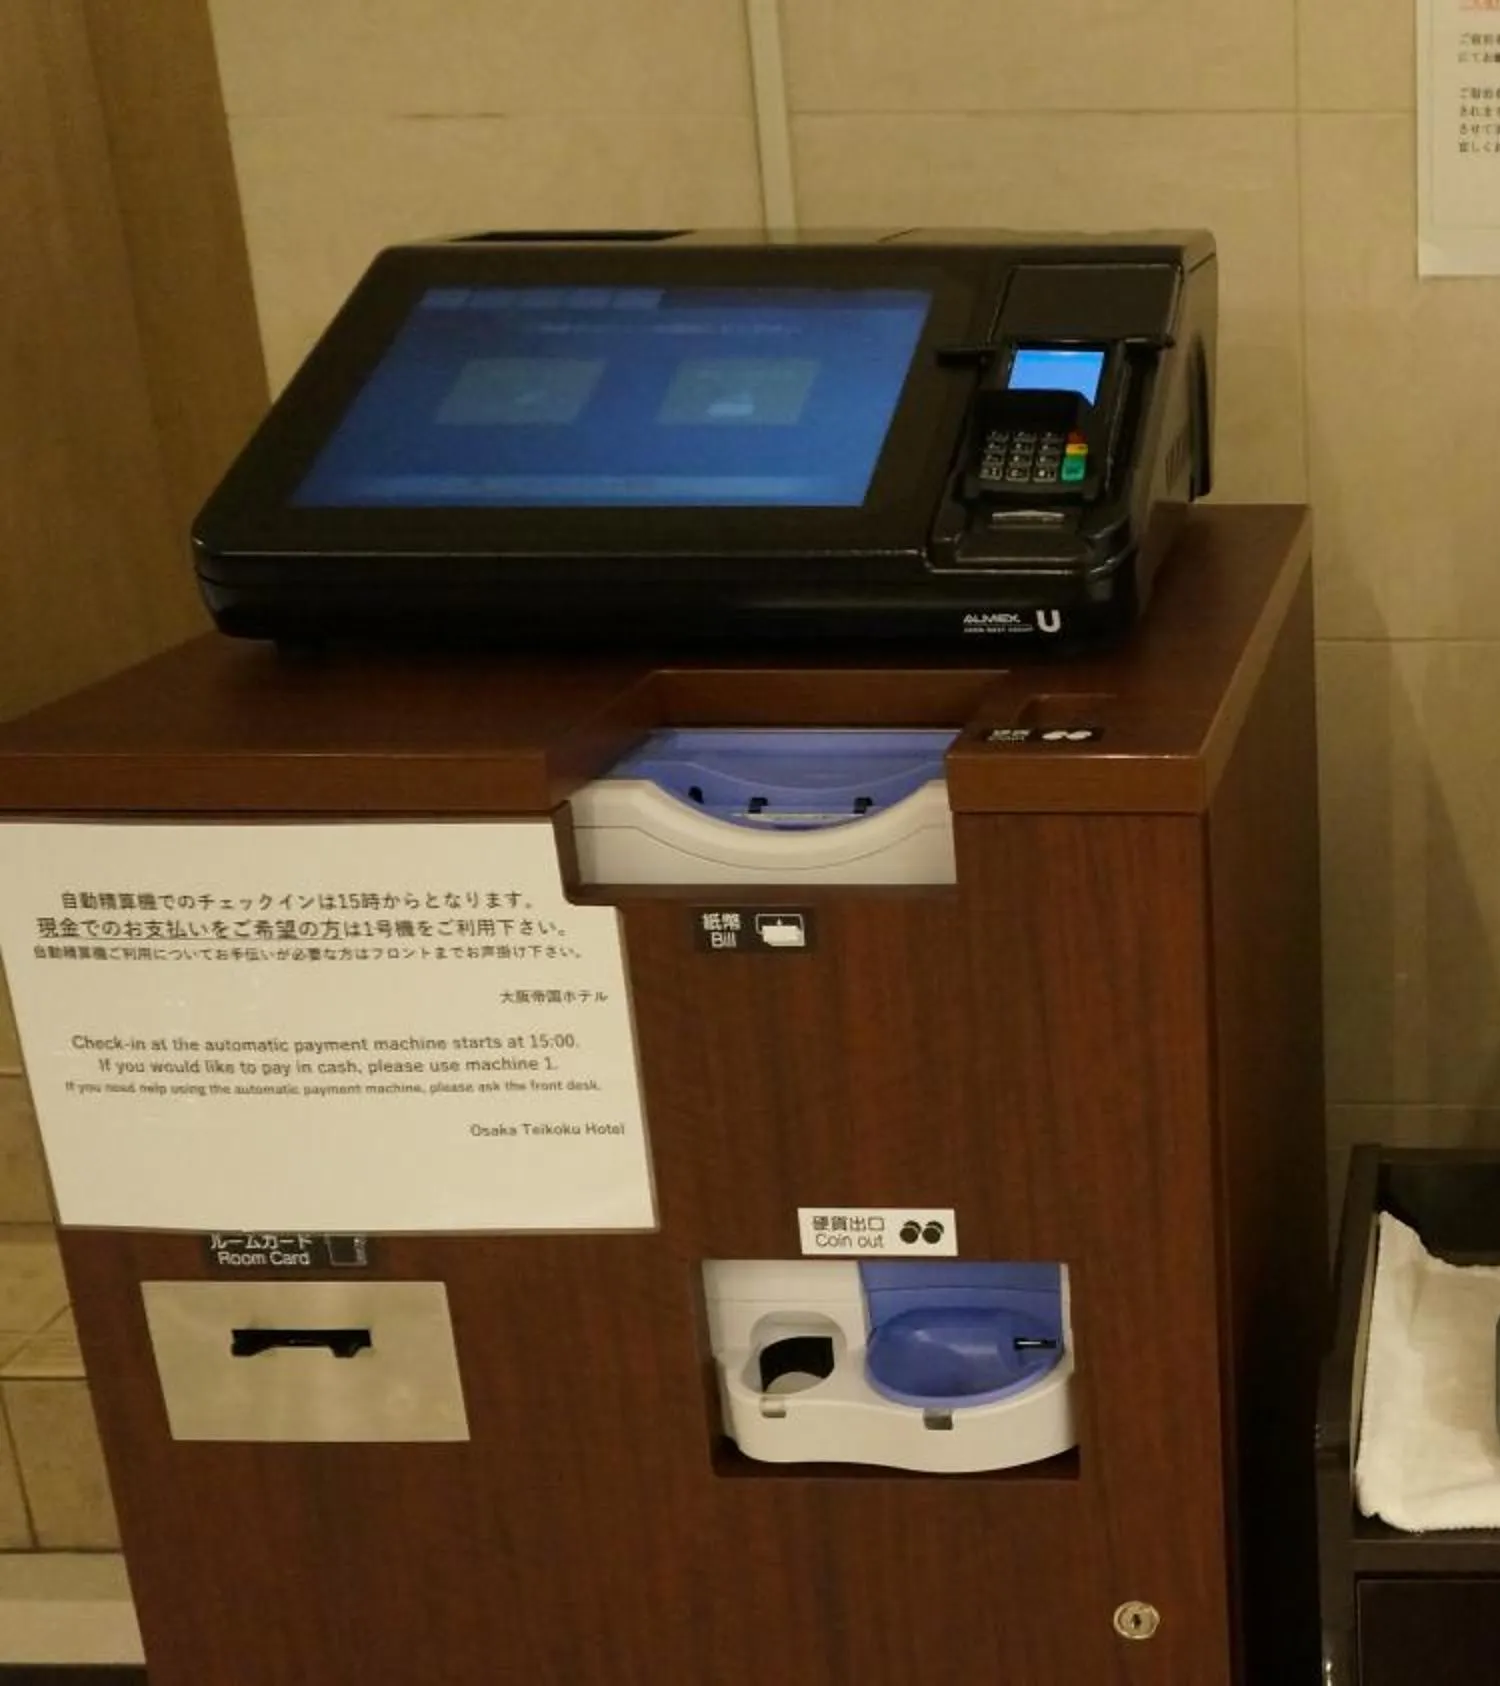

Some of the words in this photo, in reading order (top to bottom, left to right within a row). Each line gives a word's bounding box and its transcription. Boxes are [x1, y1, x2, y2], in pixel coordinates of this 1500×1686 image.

[61, 891, 533, 910] 自動精算機でのチェックインは15時からとなります。
[703, 913, 741, 931] 紙幣
[711, 931, 736, 948] Bill
[500, 989, 608, 1004] 大阪帝国ホテル
[71, 1034, 146, 1051] Check-in
[151, 1038, 168, 1051] at
[173, 1037, 200, 1051] the
[205, 1037, 289, 1053] automatic
[294, 1037, 368, 1054] payment
[373, 1036, 447, 1051] machine
[452, 1036, 505, 1050] starts
[507, 1035, 523, 1049] at
[98, 1058, 110, 1072] If
[115, 1061, 145, 1075] you
[150, 1059, 200, 1073] would
[205, 1059, 234, 1073] like
[240, 1060, 257, 1074] to
[262, 1062, 291, 1077] pay
[297, 1059, 312, 1073] in
[368, 1058, 424, 1075] please
[430, 1060, 460, 1072] use
[465, 1056, 539, 1071] machine
[470, 1123, 517, 1137] Osaka
[522, 1123, 581, 1136] Teikoku
[585, 1122, 625, 1135] Hotel
[812, 1215, 885, 1232] 硬貨出口
[815, 1232, 852, 1248] Coin
[858, 1233, 884, 1248] out
[217, 1251, 267, 1265] Room
[270, 1251, 311, 1265] Card
